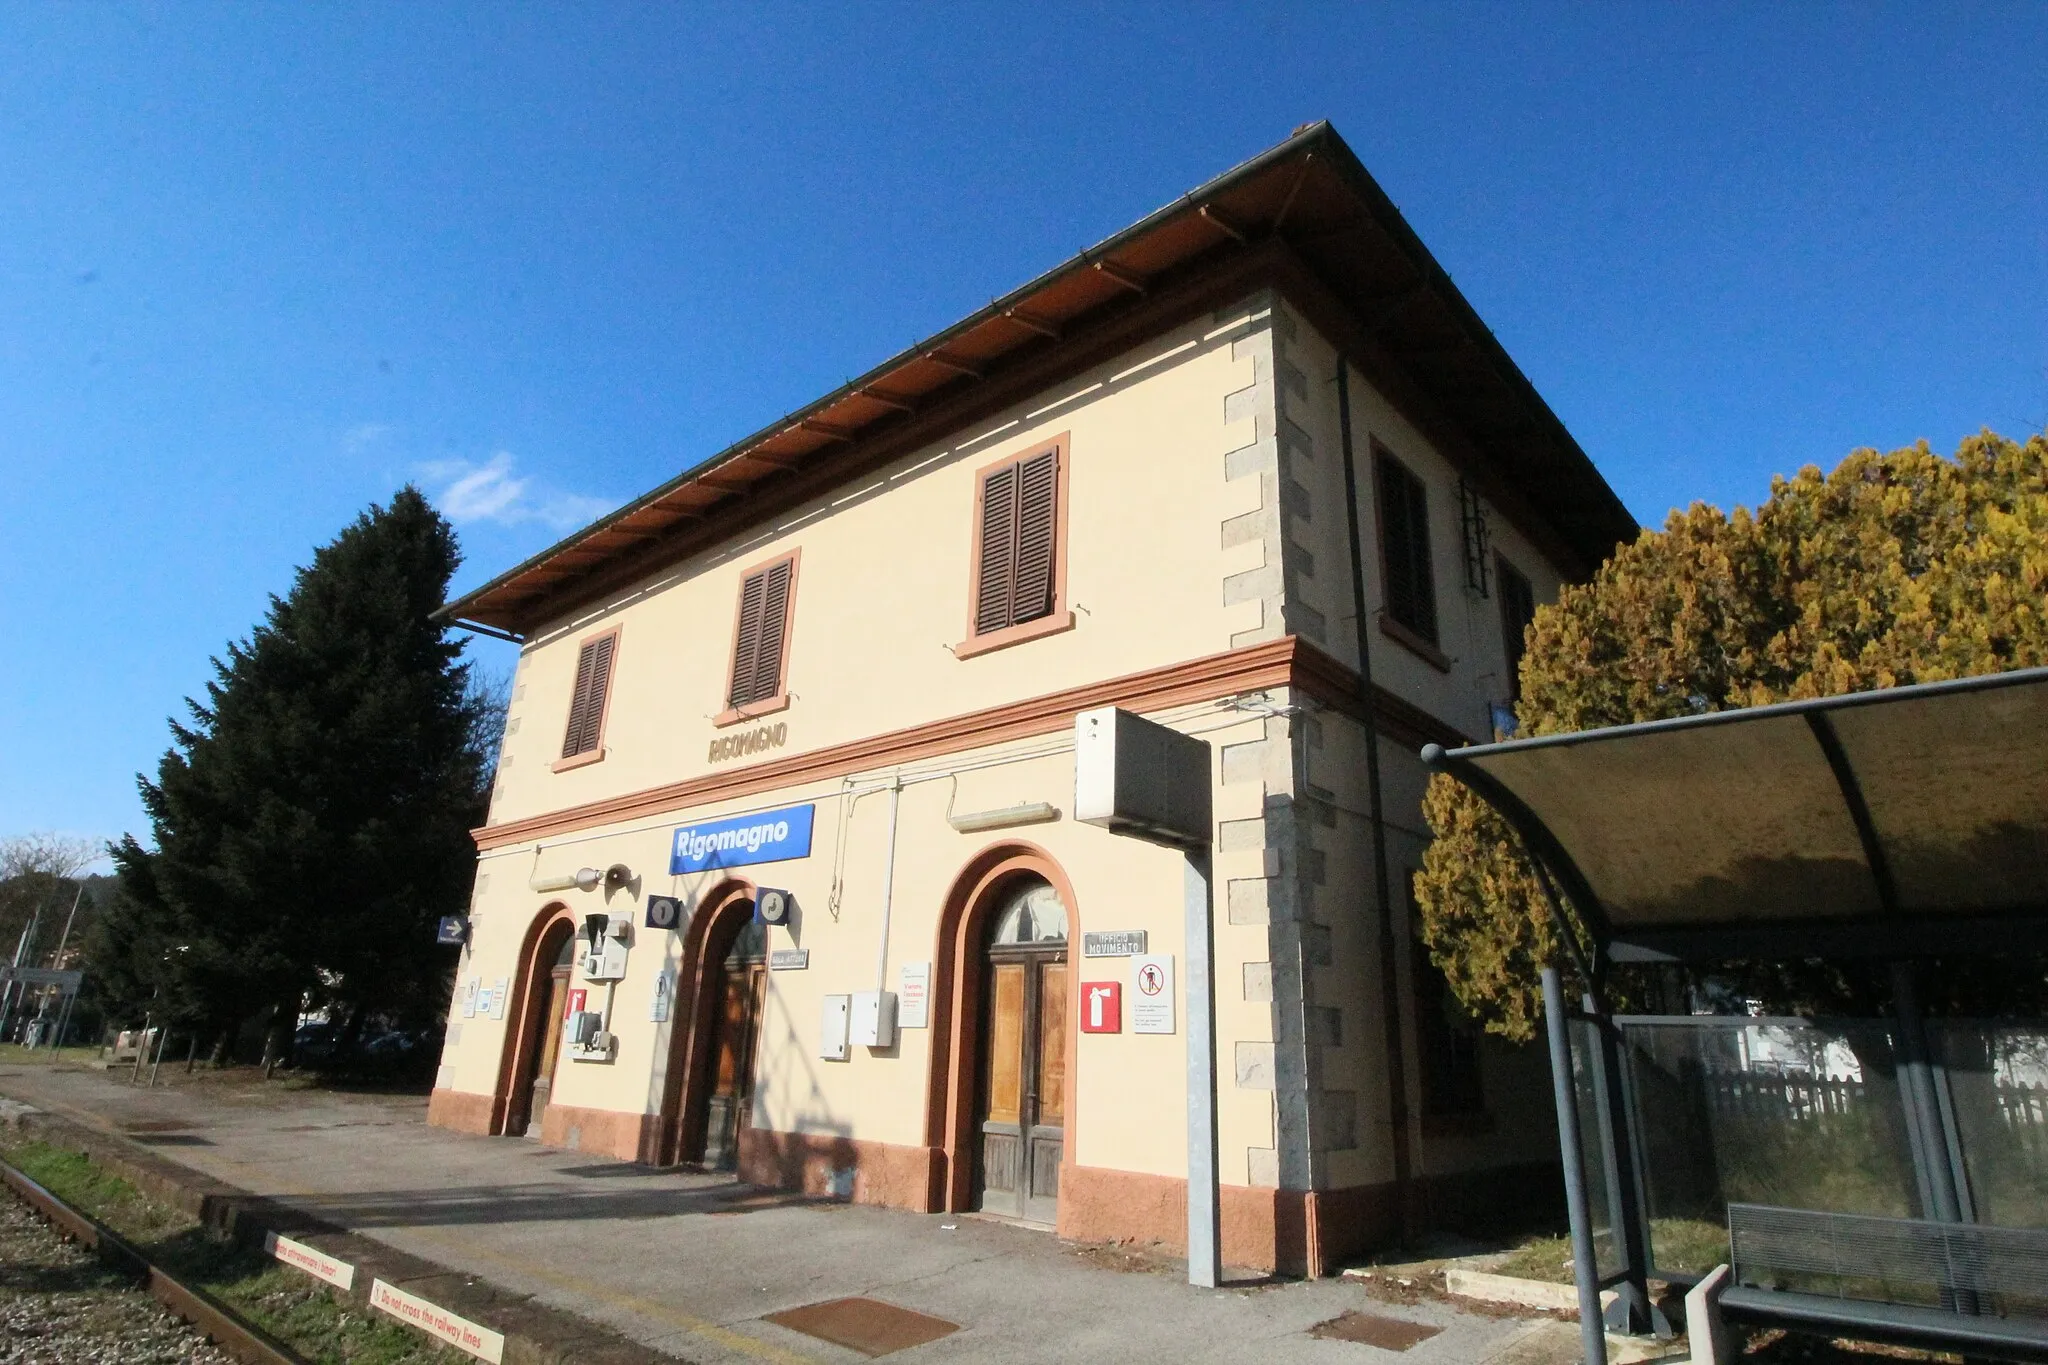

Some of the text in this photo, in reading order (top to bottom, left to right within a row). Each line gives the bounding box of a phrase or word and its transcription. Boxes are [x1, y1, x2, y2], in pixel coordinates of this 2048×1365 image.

[708, 721, 788, 764] RIGOMAGNO
[677, 821, 789, 861] Rigomagno
[1089, 942, 1139, 954] MOVIMENTO
[1099, 932, 1128, 943] UFFICIO
[381, 1289, 481, 1349] Do not cross the railway lines
